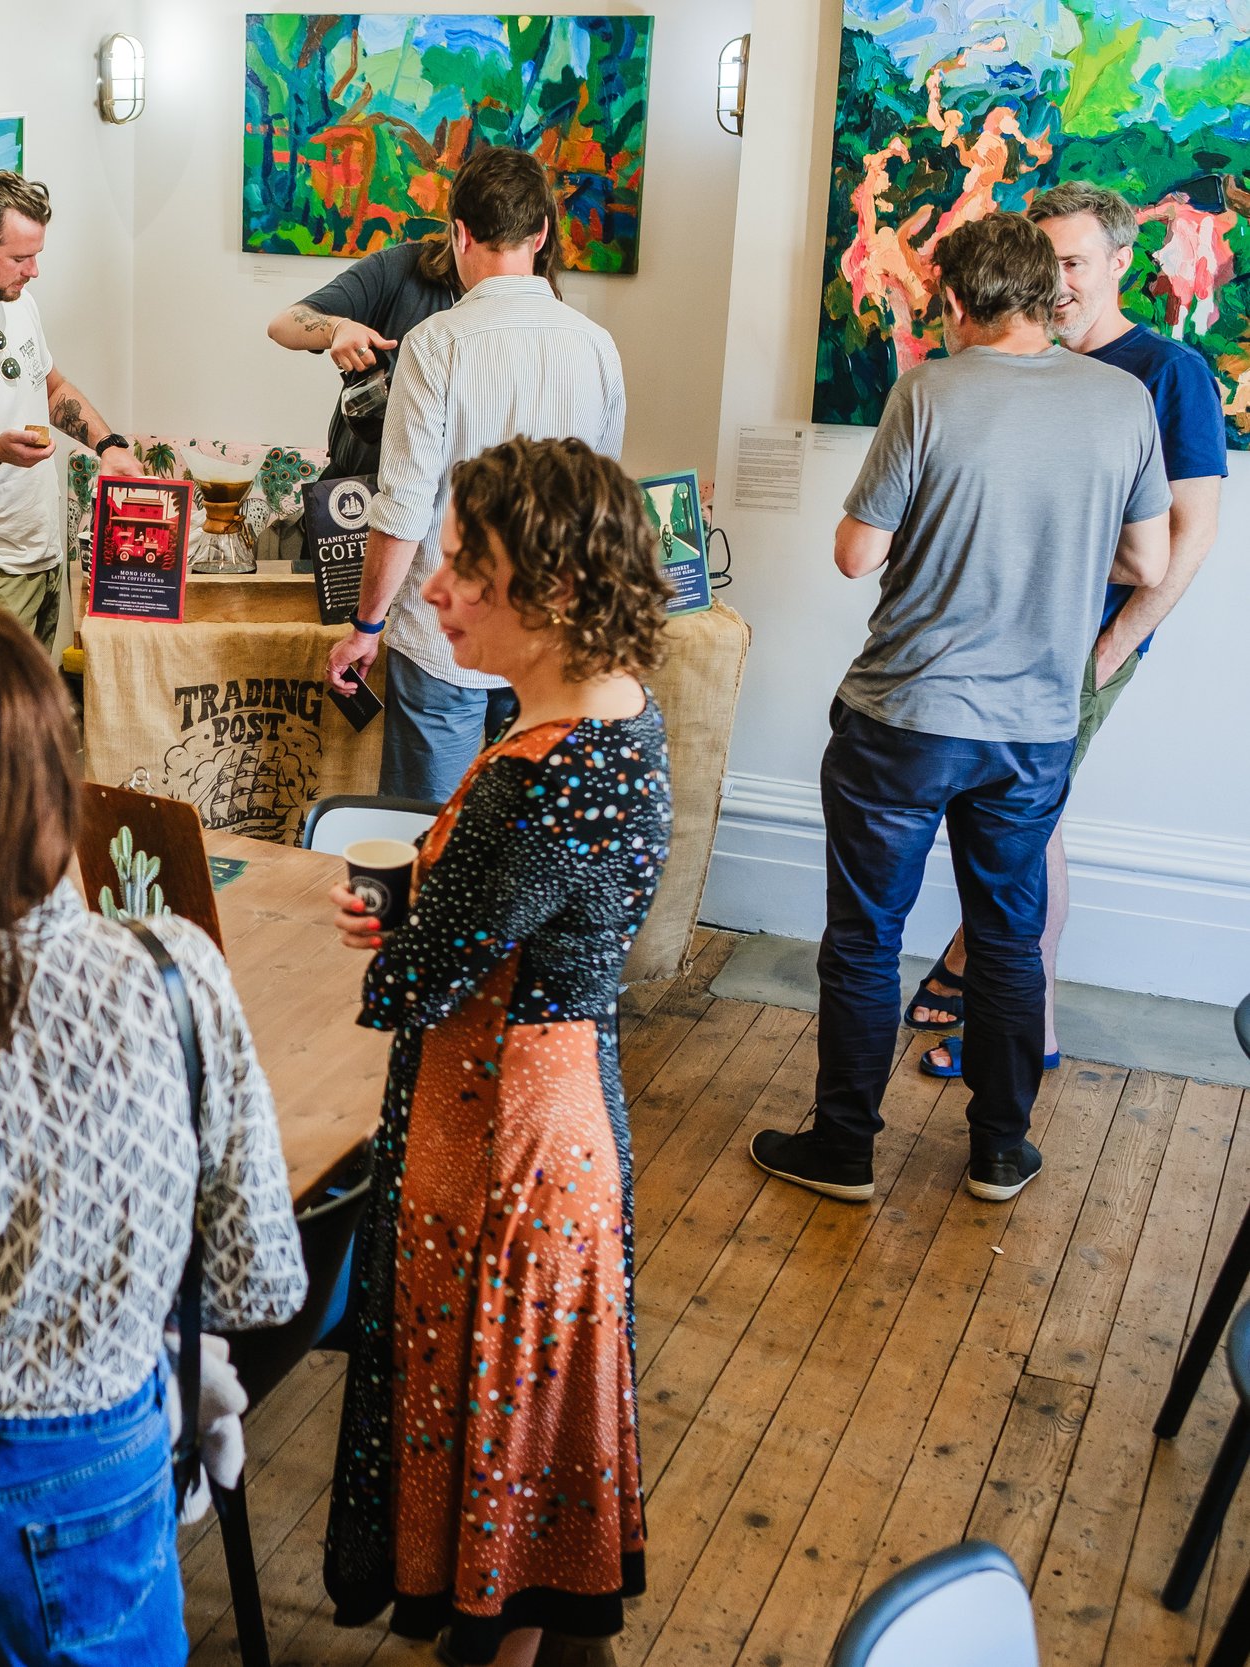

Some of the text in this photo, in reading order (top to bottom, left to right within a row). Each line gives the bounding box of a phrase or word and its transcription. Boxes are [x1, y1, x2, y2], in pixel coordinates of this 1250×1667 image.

[669, 564, 690, 573] MONKEY
[175, 678, 324, 732] TRADING
[212, 713, 287, 748] POST
